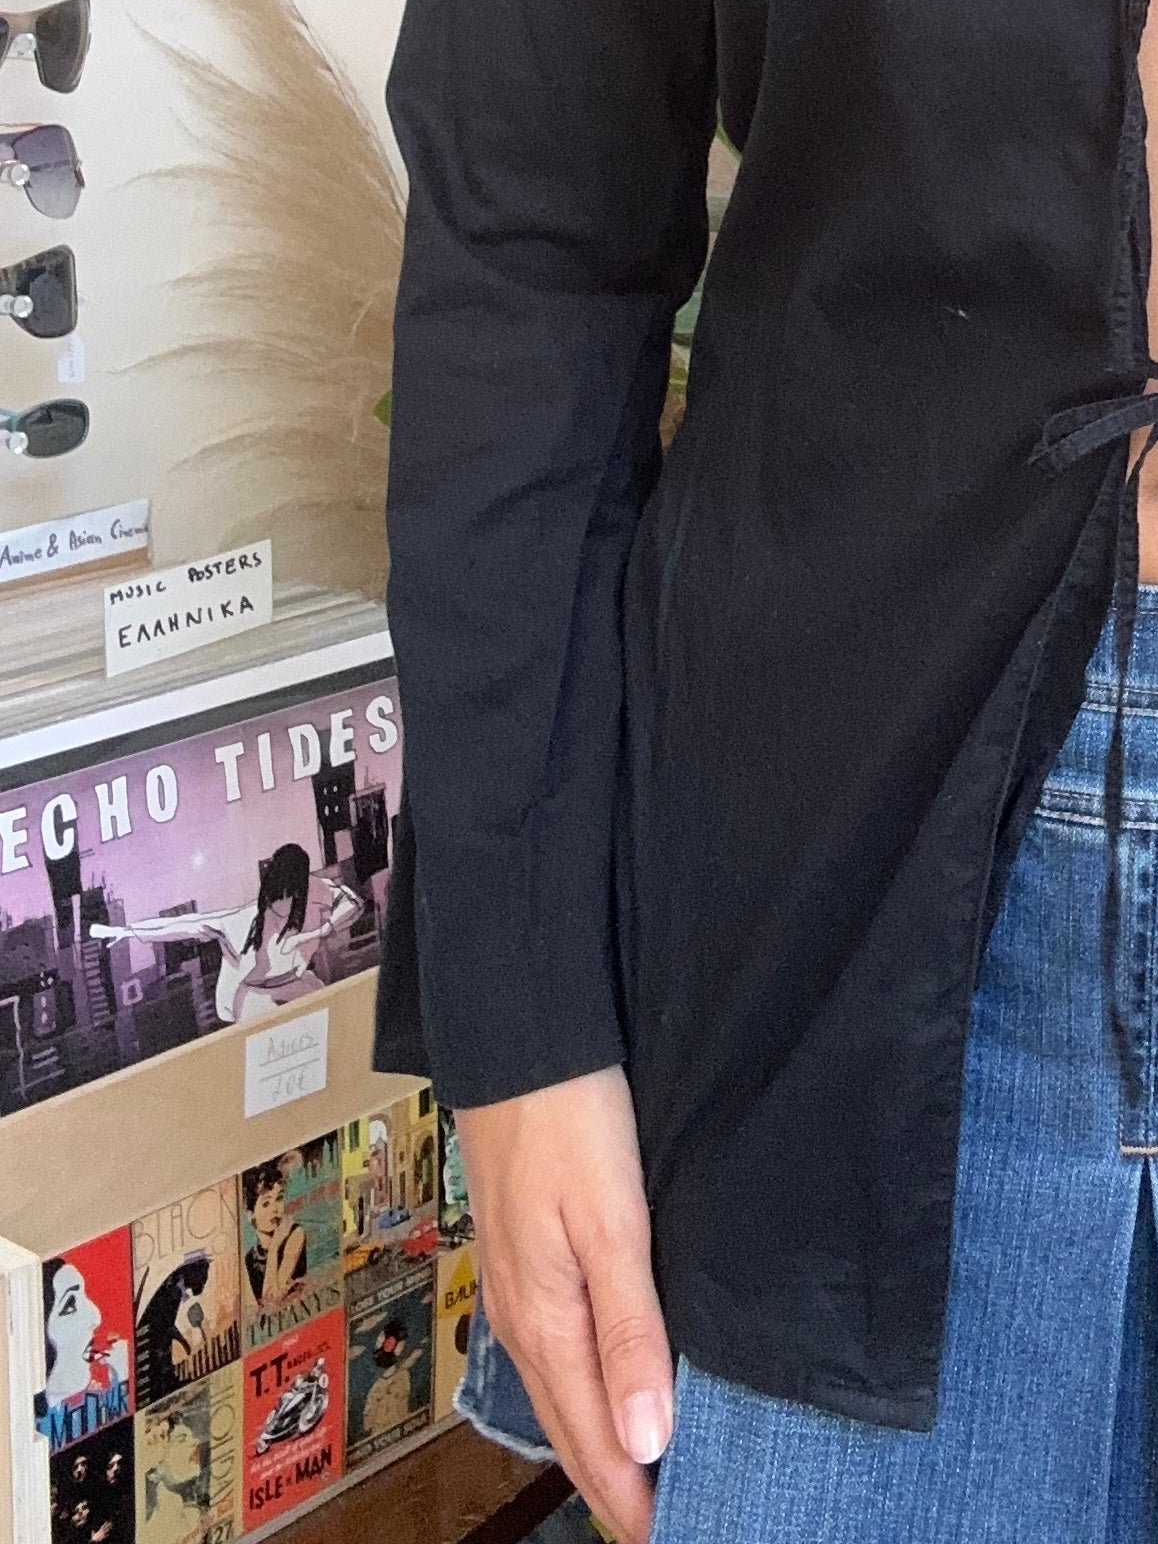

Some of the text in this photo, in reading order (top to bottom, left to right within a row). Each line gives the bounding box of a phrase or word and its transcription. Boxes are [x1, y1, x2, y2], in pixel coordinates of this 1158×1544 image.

[47, 532, 59, 558] &
[69, 529, 103, 551] Asian
[109, 551, 263, 606] MUSIC POSTERS
[0, 694, 399, 875] ECHO TIDES
[132, 1184, 239, 1272] BLACK
[249, 1474, 284, 1511] ISLE
[295, 1442, 333, 1486] MAN
